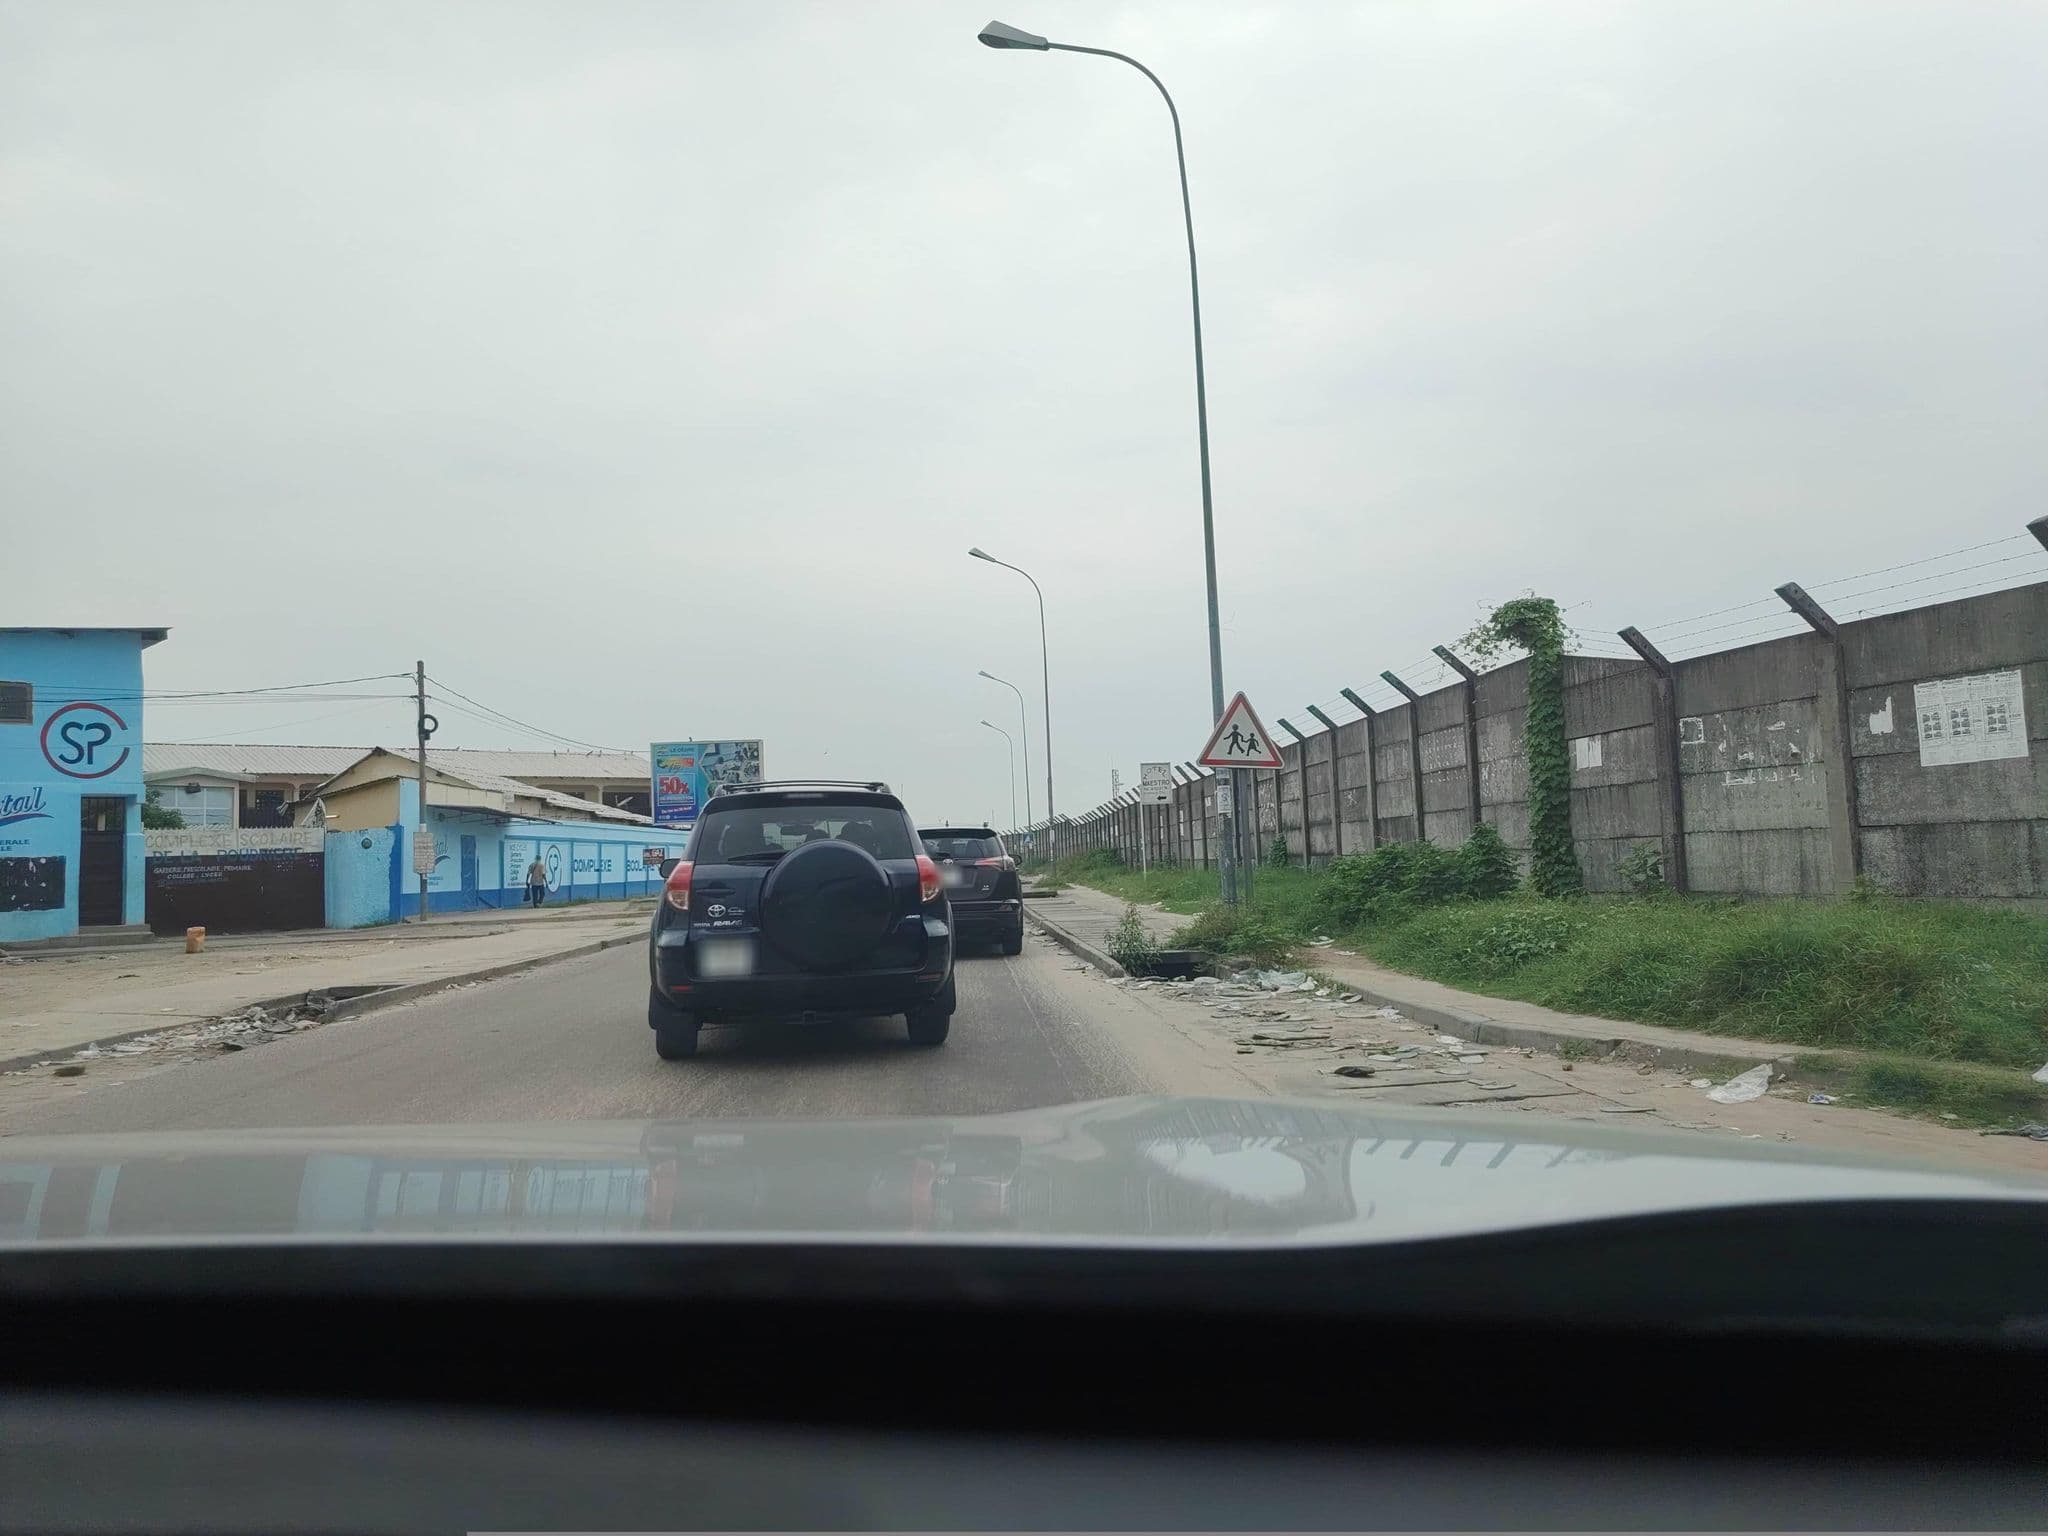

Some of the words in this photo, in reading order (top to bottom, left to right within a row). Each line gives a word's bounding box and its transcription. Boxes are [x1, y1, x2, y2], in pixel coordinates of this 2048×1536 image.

[659, 776, 689, 795] 50%
[0, 786, 47, 817] tal
[145, 833, 232, 849] COMPLEXE
[239, 831, 315, 847] SCOLAIRE
[153, 850, 173, 864] DE
[180, 849, 203, 863] LA
[573, 859, 613, 873] COMPLEXE
